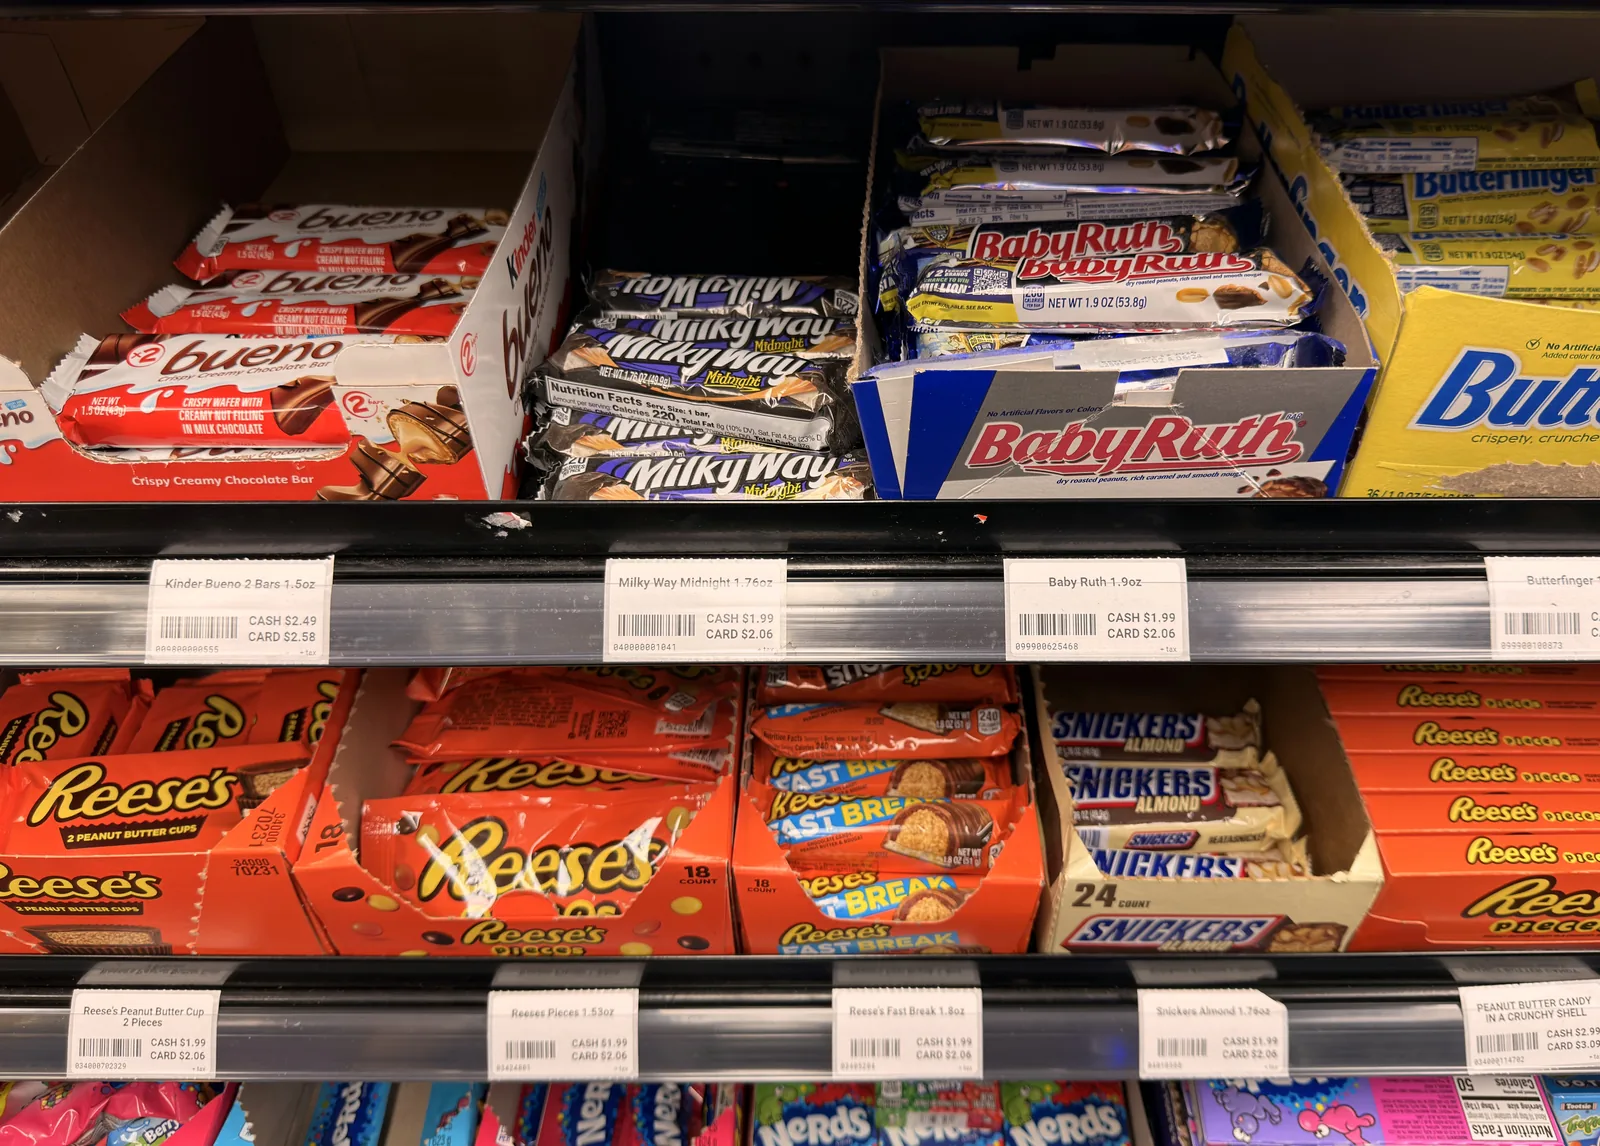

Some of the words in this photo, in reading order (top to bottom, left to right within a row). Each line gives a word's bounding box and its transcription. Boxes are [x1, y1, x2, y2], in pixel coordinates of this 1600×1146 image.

[506, 212, 538, 289] Kinder
[316, 255, 343, 265] CREAMY
[344, 255, 358, 265] NUT
[360, 255, 385, 265] FILLING
[1049, 298, 1067, 309] NET
[1068, 298, 1082, 309] WT
[1085, 298, 1099, 308] 1.9
[1101, 297, 1113, 308] OZ
[1115, 296, 1147, 310] (53.8g)
[273, 314, 302, 325] CREAMY
[303, 315, 319, 324] NUT
[320, 315, 347, 324] FILLING
[160, 339, 343, 376] bueno
[157, 372, 197, 383] Crispy
[198, 369, 244, 379] Creamy
[247, 363, 309, 375] Chocolate
[309, 360, 331, 368] Bar
[704, 370, 763, 389] Midnight
[551, 382, 605, 401] Nutrition
[608, 392, 643, 406] Facts
[182, 397, 212, 407] CRISPY
[213, 397, 240, 407] WAFER
[241, 397, 263, 407] WITH
[348, 395, 369, 413] 2
[179, 410, 213, 421] CREAMY
[214, 410, 230, 421] NUT
[231, 410, 264, 421] FILLING
[646, 401, 666, 411] Serv.
[667, 405, 687, 414] Size:
[694, 410, 711, 418] bar,
[1000, 408, 1033, 417] Artificial
[1035, 406, 1064, 415] Flavors
[612, 404, 651, 418] Calories
[652, 409, 680, 423] 220,
[682, 417, 701, 426] Total
[702, 420, 715, 428] Fat
[182, 424, 189, 434] IN
[190, 424, 213, 434] MILK
[214, 423, 264, 435] CHOCOLATE
[1471, 433, 1534, 445] crispety,
[131, 476, 171, 488] Crispy
[173, 476, 222, 488] Creamy
[224, 475, 289, 486] Chocolate
[291, 475, 314, 485] Bar
[744, 482, 802, 499] Midnight
[165, 578, 203, 589] Kinder
[205, 578, 242, 589] Bueno
[244, 579, 251, 588] 2
[255, 579, 280, 589] Bars
[284, 579, 316, 589] 1.5oz
[618, 577, 650, 590] Milky
[653, 577, 677, 590] Way
[680, 577, 731, 590] Midnight
[734, 577, 773, 588] 1.76oz
[1049, 577, 1077, 589] Baby
[1080, 577, 1107, 587] Ruth
[1110, 577, 1142, 587] 1.9oz
[1527, 575, 1594, 588] Butterfinger
[249, 615, 281, 626] CASH
[285, 615, 317, 627] $2.49
[706, 613, 739, 624] CASH
[742, 613, 774, 625] $1.99
[1108, 613, 1140, 623] CASH
[1143, 612, 1176, 624] $1.99
[249, 631, 280, 642] CARD
[284, 631, 316, 643] $2.58
[706, 629, 738, 639] CARD
[741, 628, 774, 640] $2.06
[1107, 628, 1140, 639] CARD
[1143, 628, 1176, 640] $2.06
[1015, 642, 1079, 651] 099900625468
[1052, 711, 1202, 741] SNICKERS
[28, 763, 240, 826] Reese's
[1135, 794, 1201, 813] ALMOND
[67, 834, 75, 844] 2
[76, 831, 123, 843] PEANUT
[124, 828, 168, 840] BUTTER
[168, 824, 197, 837] CUPS
[230, 866, 280, 877] 70231
[684, 866, 711, 878] 18
[754, 879, 770, 888] 18
[1071, 882, 1117, 908] 24
[1118, 900, 1152, 908] COUNT
[462, 920, 608, 944] Reese's
[779, 923, 892, 947] Reese's
[1078, 914, 1268, 944] SNICKERS
[1476, 1001, 1516, 1012] PEANUT
[1518, 999, 1557, 1010] BUTTER
[1558, 996, 1592, 1008] CANDY
[83, 1006, 118, 1016] Reese's
[120, 1007, 153, 1016] Peanut
[155, 1007, 184, 1016] Butter
[186, 1007, 205, 1018] Cup
[849, 1006, 885, 1016] Reese's
[887, 1006, 907, 1016] Fast
[909, 1006, 937, 1016] Break
[940, 1006, 965, 1016] 1.8oz
[1156, 1006, 1197, 1016] Snickers
[1199, 1006, 1236, 1016] Almond
[1486, 1014, 1496, 1023] IN
[1498, 1013, 1506, 1022] A
[1507, 1009, 1554, 1021] CRUNCHY
[1556, 1008, 1587, 1018] SHELL
[123, 1018, 129, 1027] 2
[131, 1018, 163, 1027] Pieces
[1546, 1029, 1573, 1038] CASH
[1575, 1026, 1600, 1037] $2.99
[151, 1038, 178, 1047] CASH
[180, 1038, 206, 1047] $1.99
[1547, 1041, 1573, 1051] CARD
[1575, 1039, 1600, 1050] $3.09
[150, 1051, 176, 1060] CARD
[179, 1051, 206, 1060] $2.06
[1457, 1077, 1475, 1092] 50
[1496, 1078, 1535, 1090] Calories
[1566, 1102, 1592, 1110] Tootsie
[1472, 1123, 1504, 1138] Facts
[1504, 1124, 1554, 1138] Nutrition
